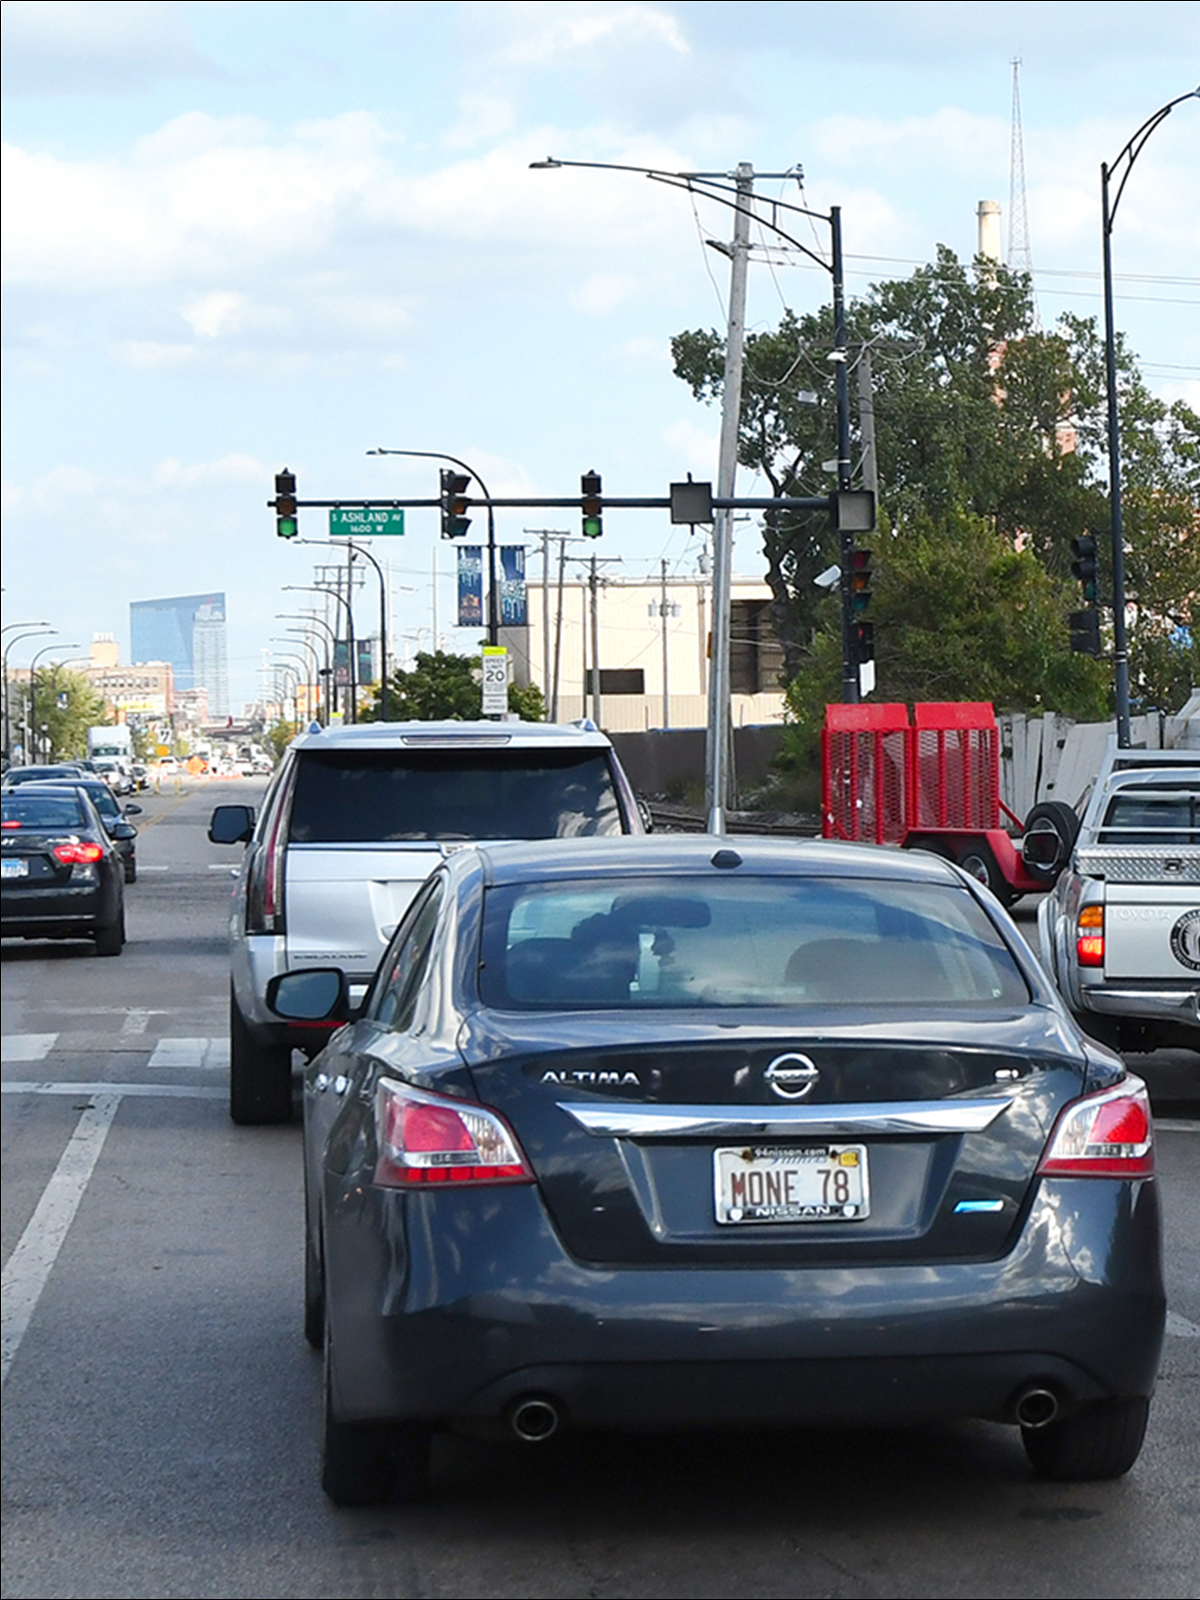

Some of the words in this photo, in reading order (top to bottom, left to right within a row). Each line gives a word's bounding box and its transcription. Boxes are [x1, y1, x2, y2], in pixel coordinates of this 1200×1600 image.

[332, 513, 337, 522] S
[341, 512, 389, 523] ASHLAND
[350, 525, 372, 533] 1600
[376, 525, 384, 533] W
[486, 670, 505, 682] 20
[1110, 908, 1172, 921] TOYOTA
[540, 1071, 640, 1085] ALTIMA
[731, 1170, 799, 1207] MONE
[817, 1169, 849, 1205] 78
[756, 1205, 830, 1217] NISSAN
